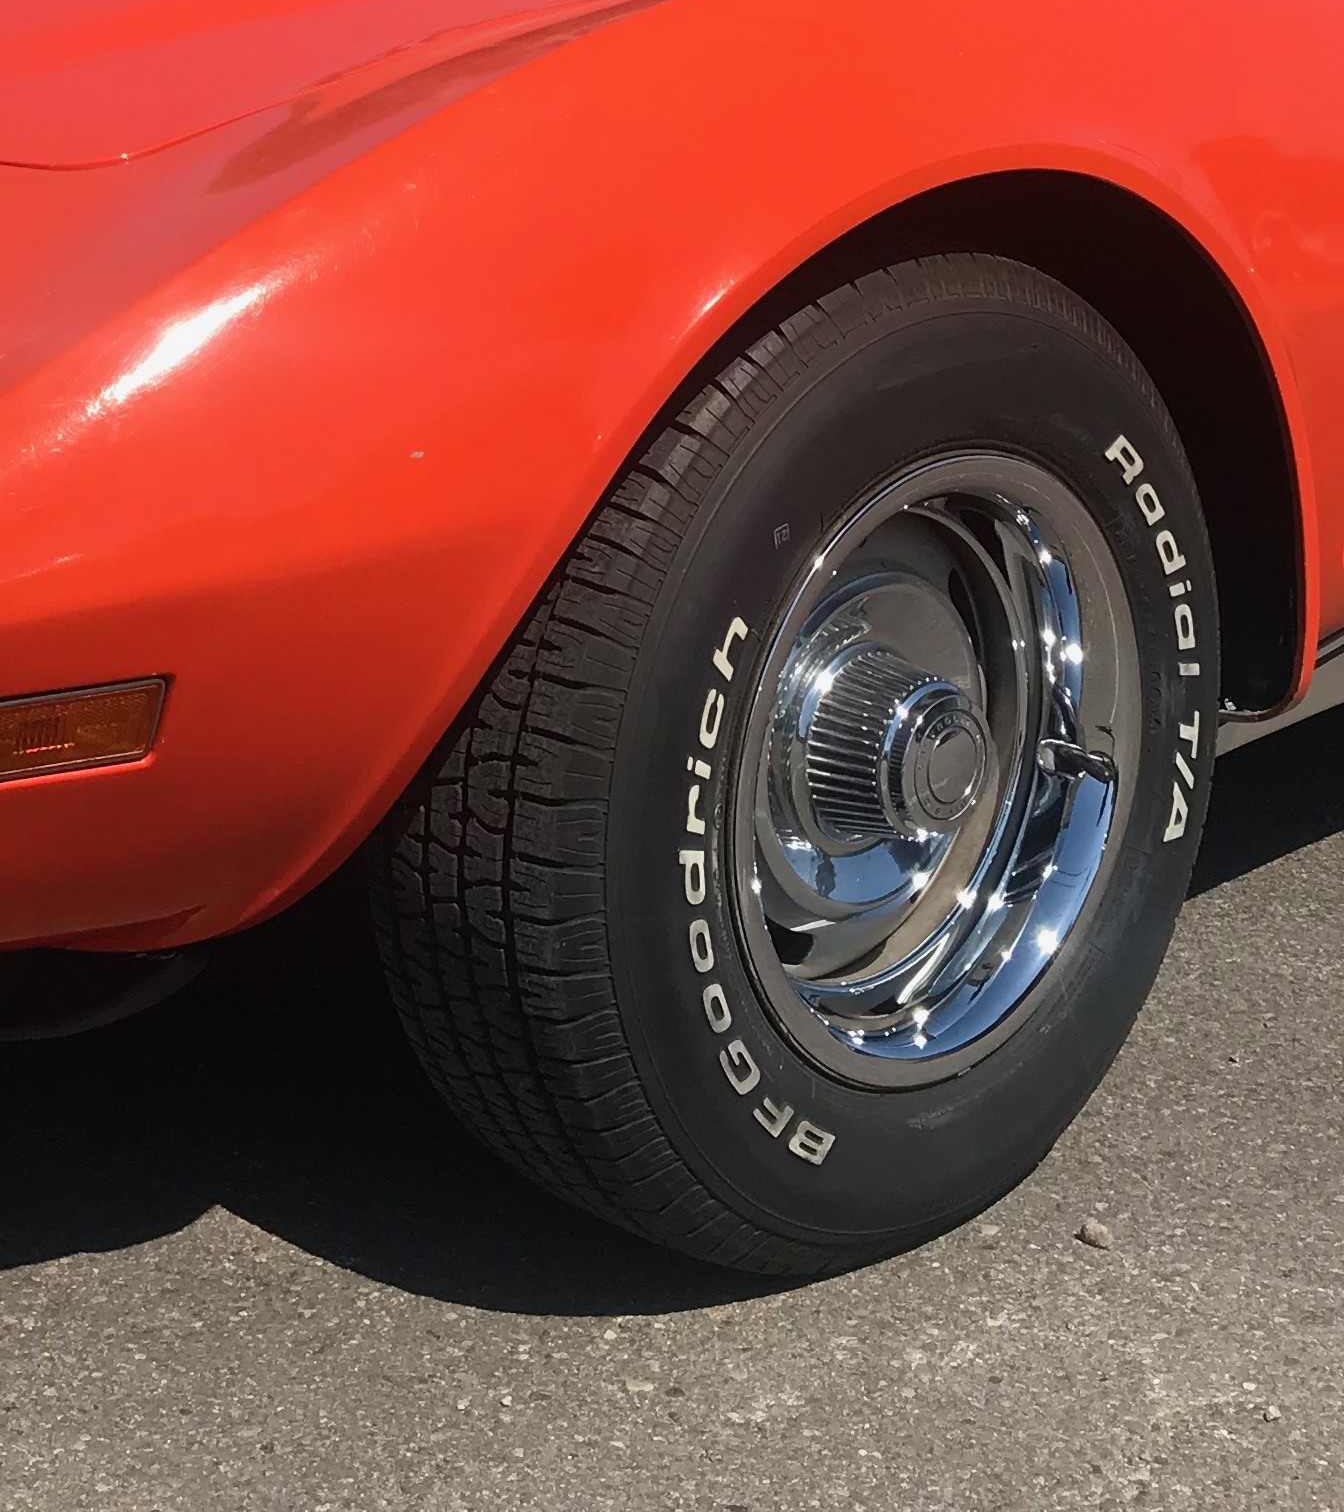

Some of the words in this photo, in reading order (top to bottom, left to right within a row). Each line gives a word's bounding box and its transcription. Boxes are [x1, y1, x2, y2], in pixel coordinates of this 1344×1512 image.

[1104, 433, 1202, 678] Radial
[1162, 710, 1201, 844] T/A
[678, 615, 837, 1167] BFGoodrich
